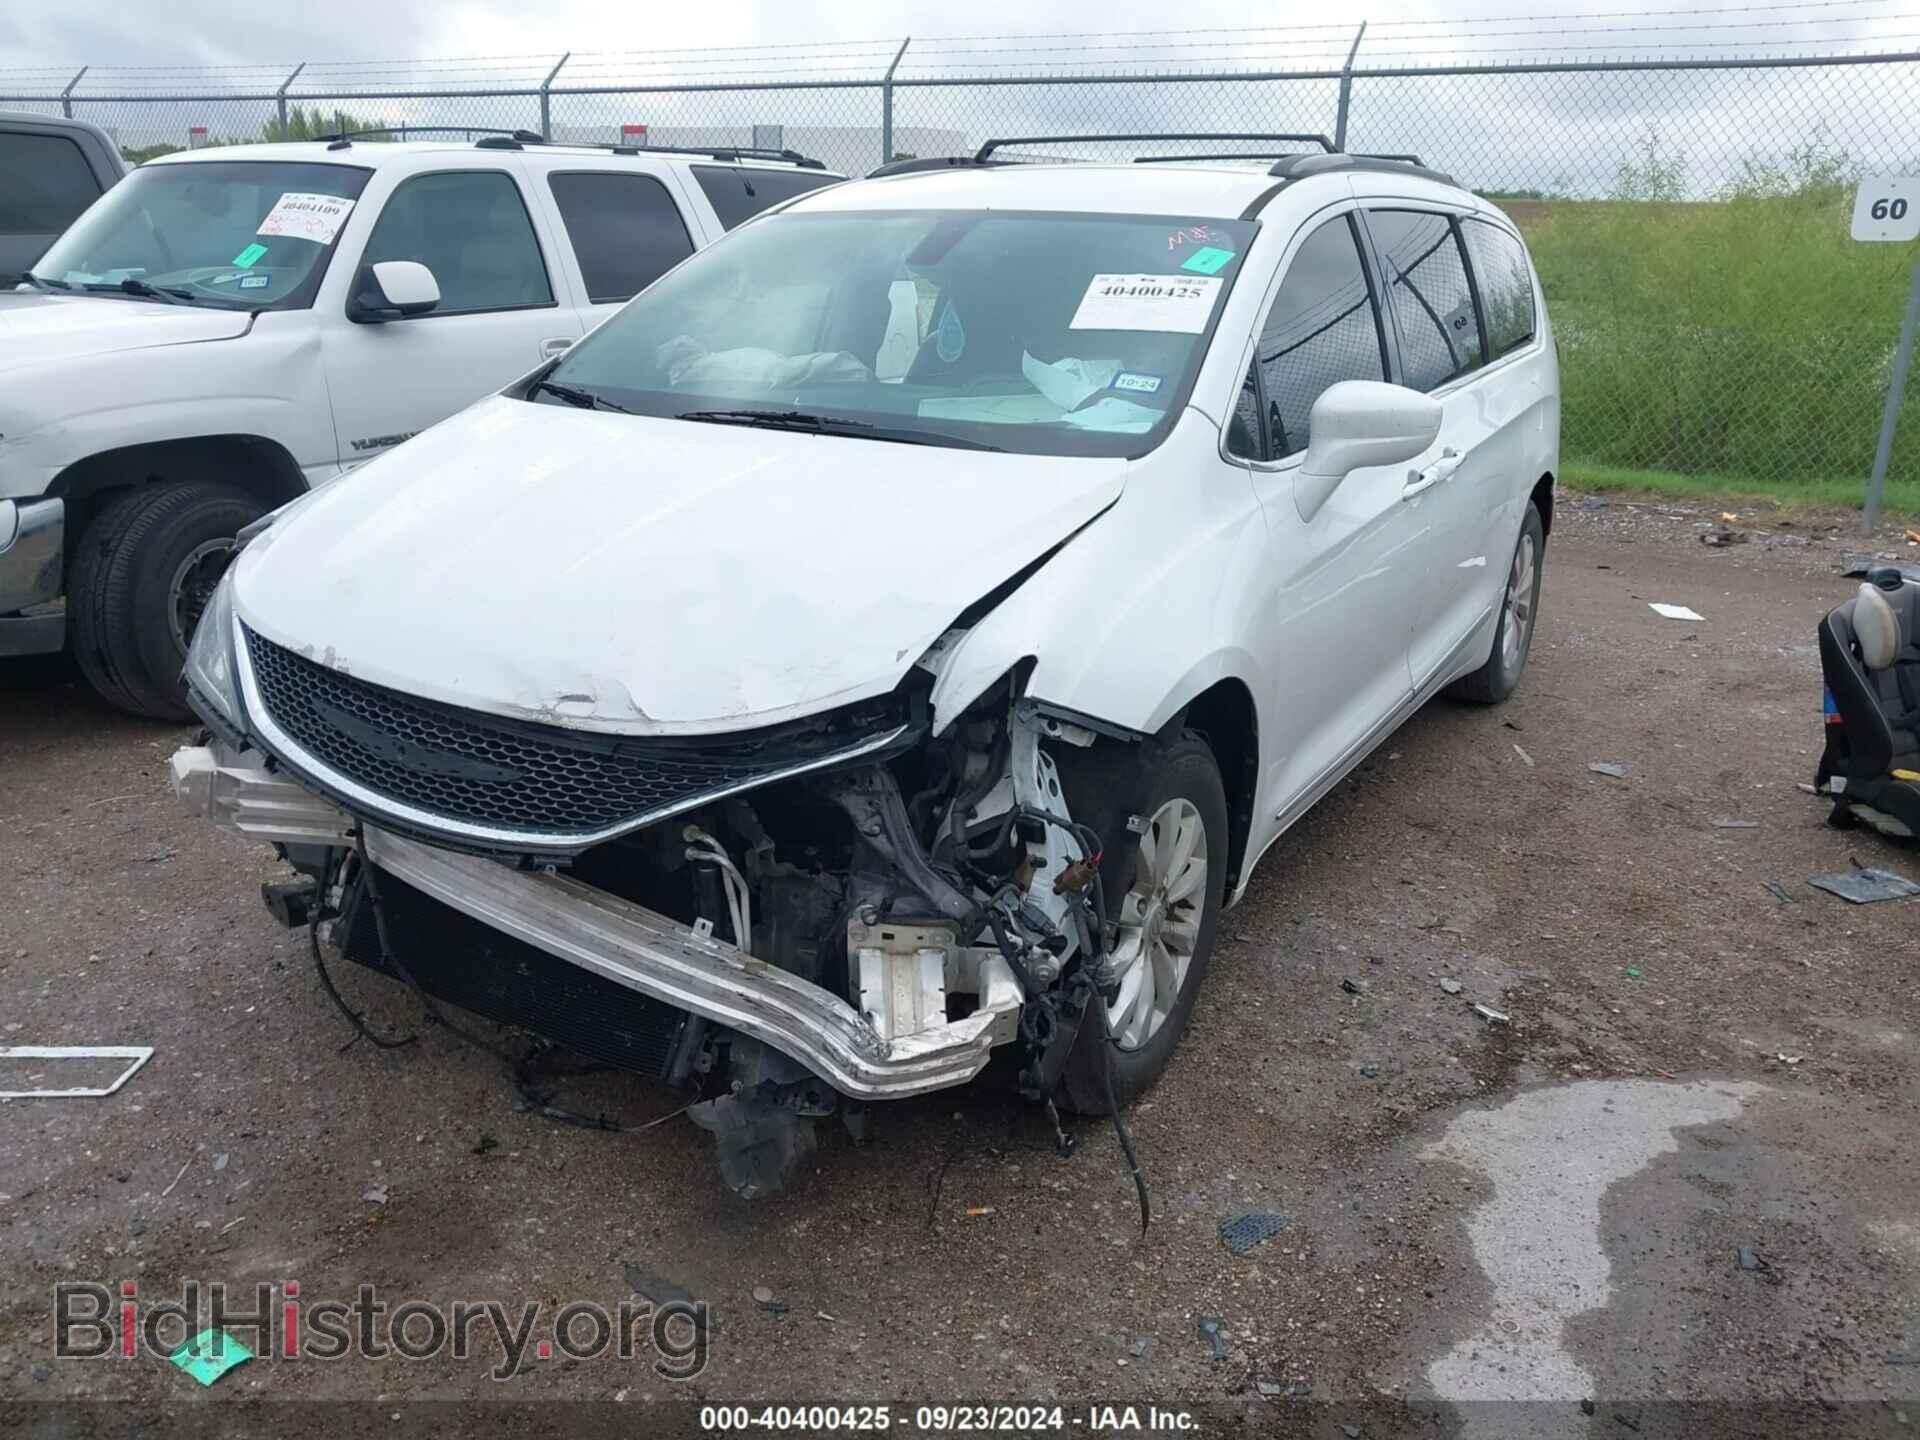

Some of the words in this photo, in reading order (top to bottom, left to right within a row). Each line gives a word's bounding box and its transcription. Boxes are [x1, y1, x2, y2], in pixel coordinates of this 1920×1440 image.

[282, 201, 341, 215] 40404109
[1871, 198, 1908, 220] 60
[1100, 284, 1203, 298] 40400425
